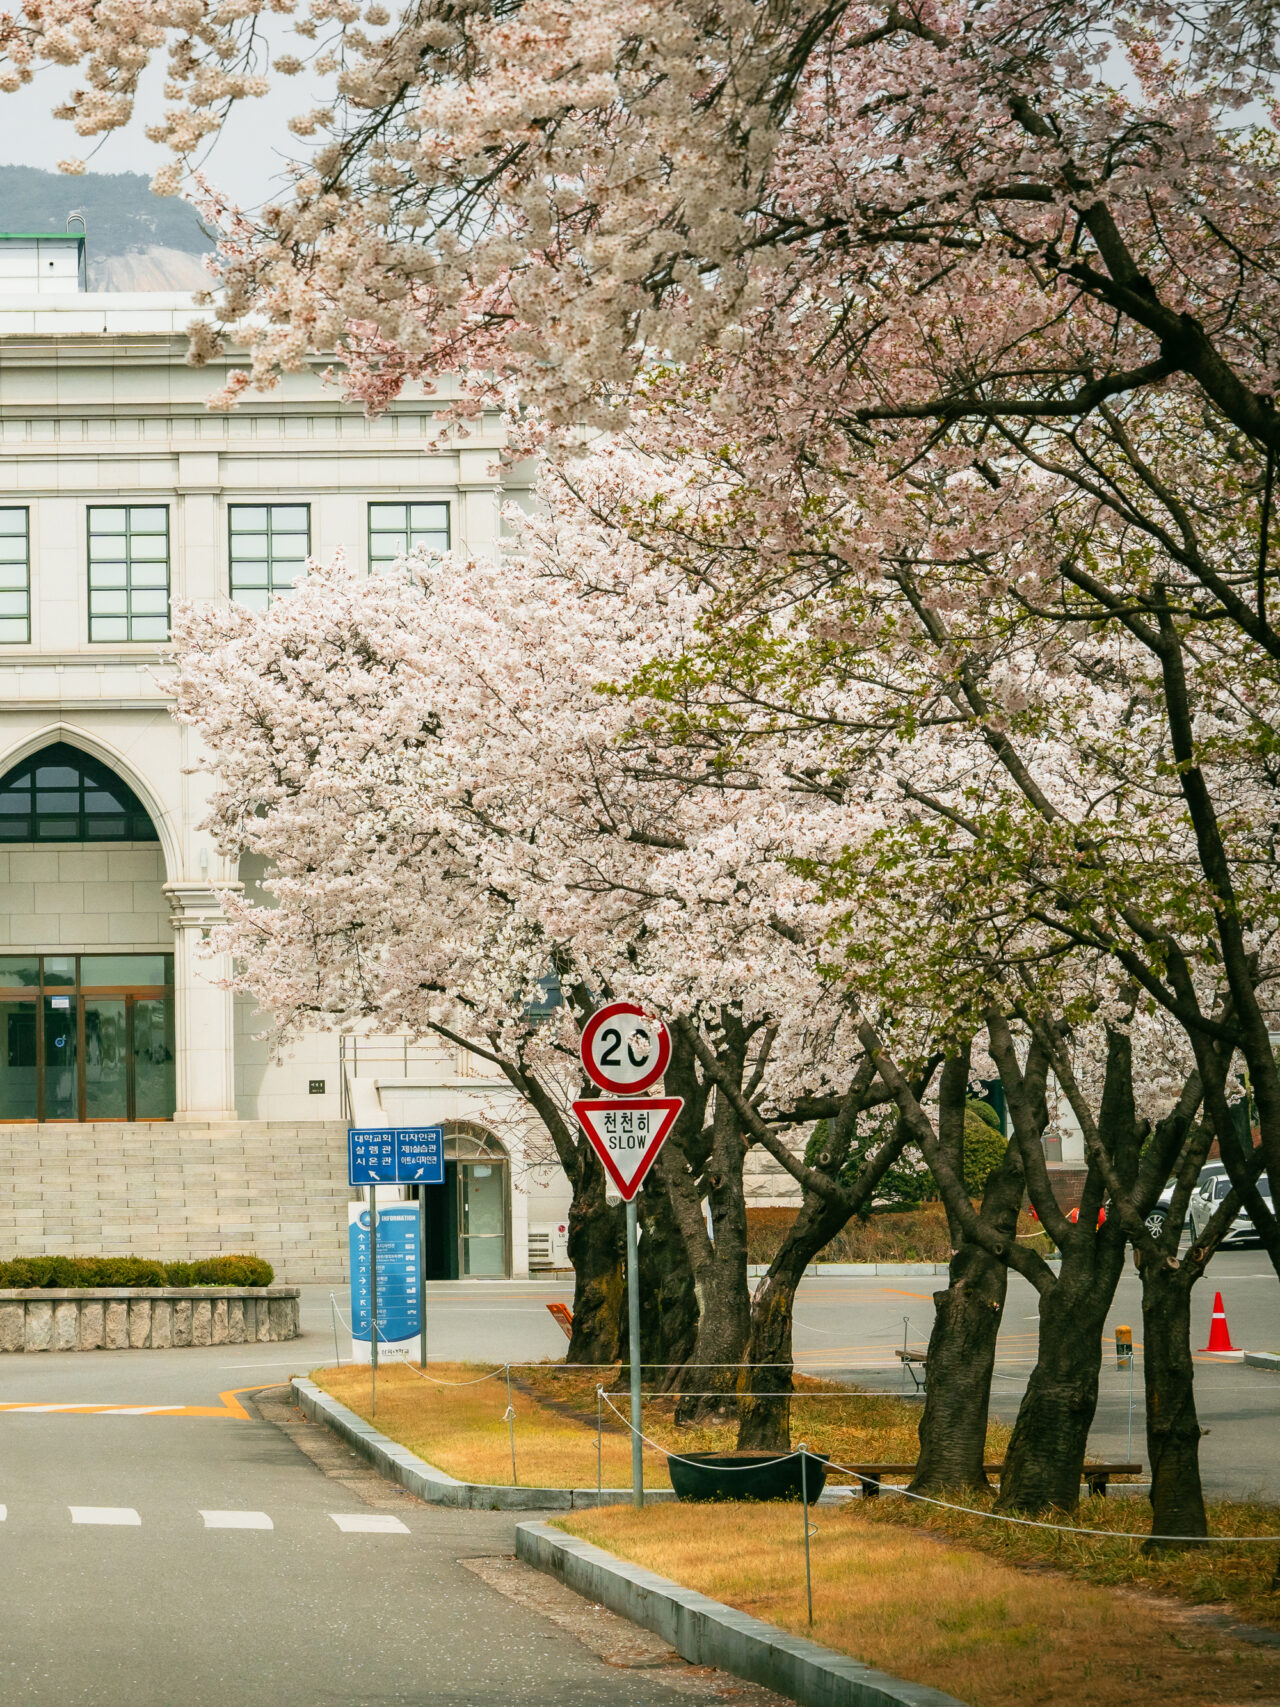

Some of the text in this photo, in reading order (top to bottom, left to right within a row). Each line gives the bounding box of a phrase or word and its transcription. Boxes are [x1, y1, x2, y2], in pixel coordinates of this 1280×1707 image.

[604, 1112, 650, 1134] 천천히
[354, 1134, 392, 1143] 대학교회
[400, 1133, 436, 1142] 디자인관
[608, 1135, 647, 1150] SLOW
[400, 1144, 436, 1154] 제1실습관
